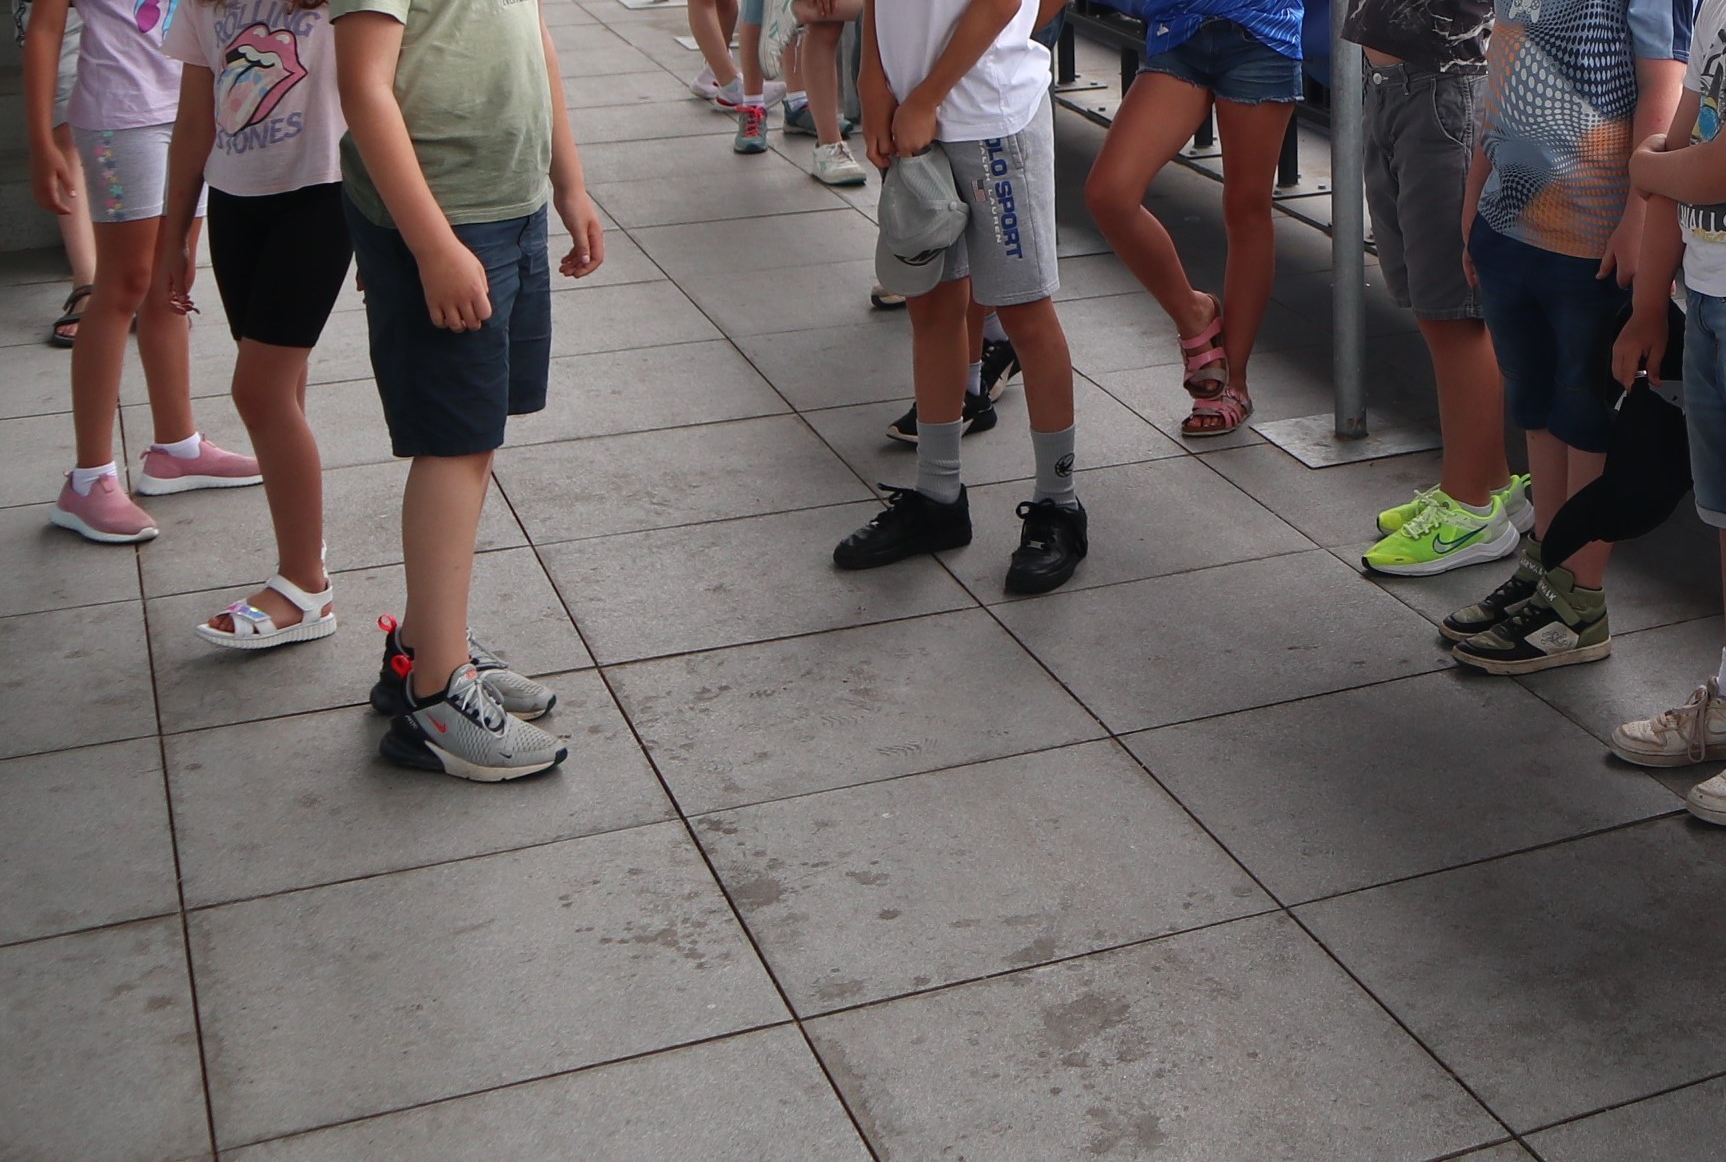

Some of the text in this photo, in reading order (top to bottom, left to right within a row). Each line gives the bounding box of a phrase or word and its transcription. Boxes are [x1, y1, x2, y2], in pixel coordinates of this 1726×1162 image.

[214, 0, 321, 48] ROLLING
[216, 112, 303, 155] STONES
[985, 138, 1023, 259] OLO SPORT
[988, 189, 1001, 243] LAUREN
